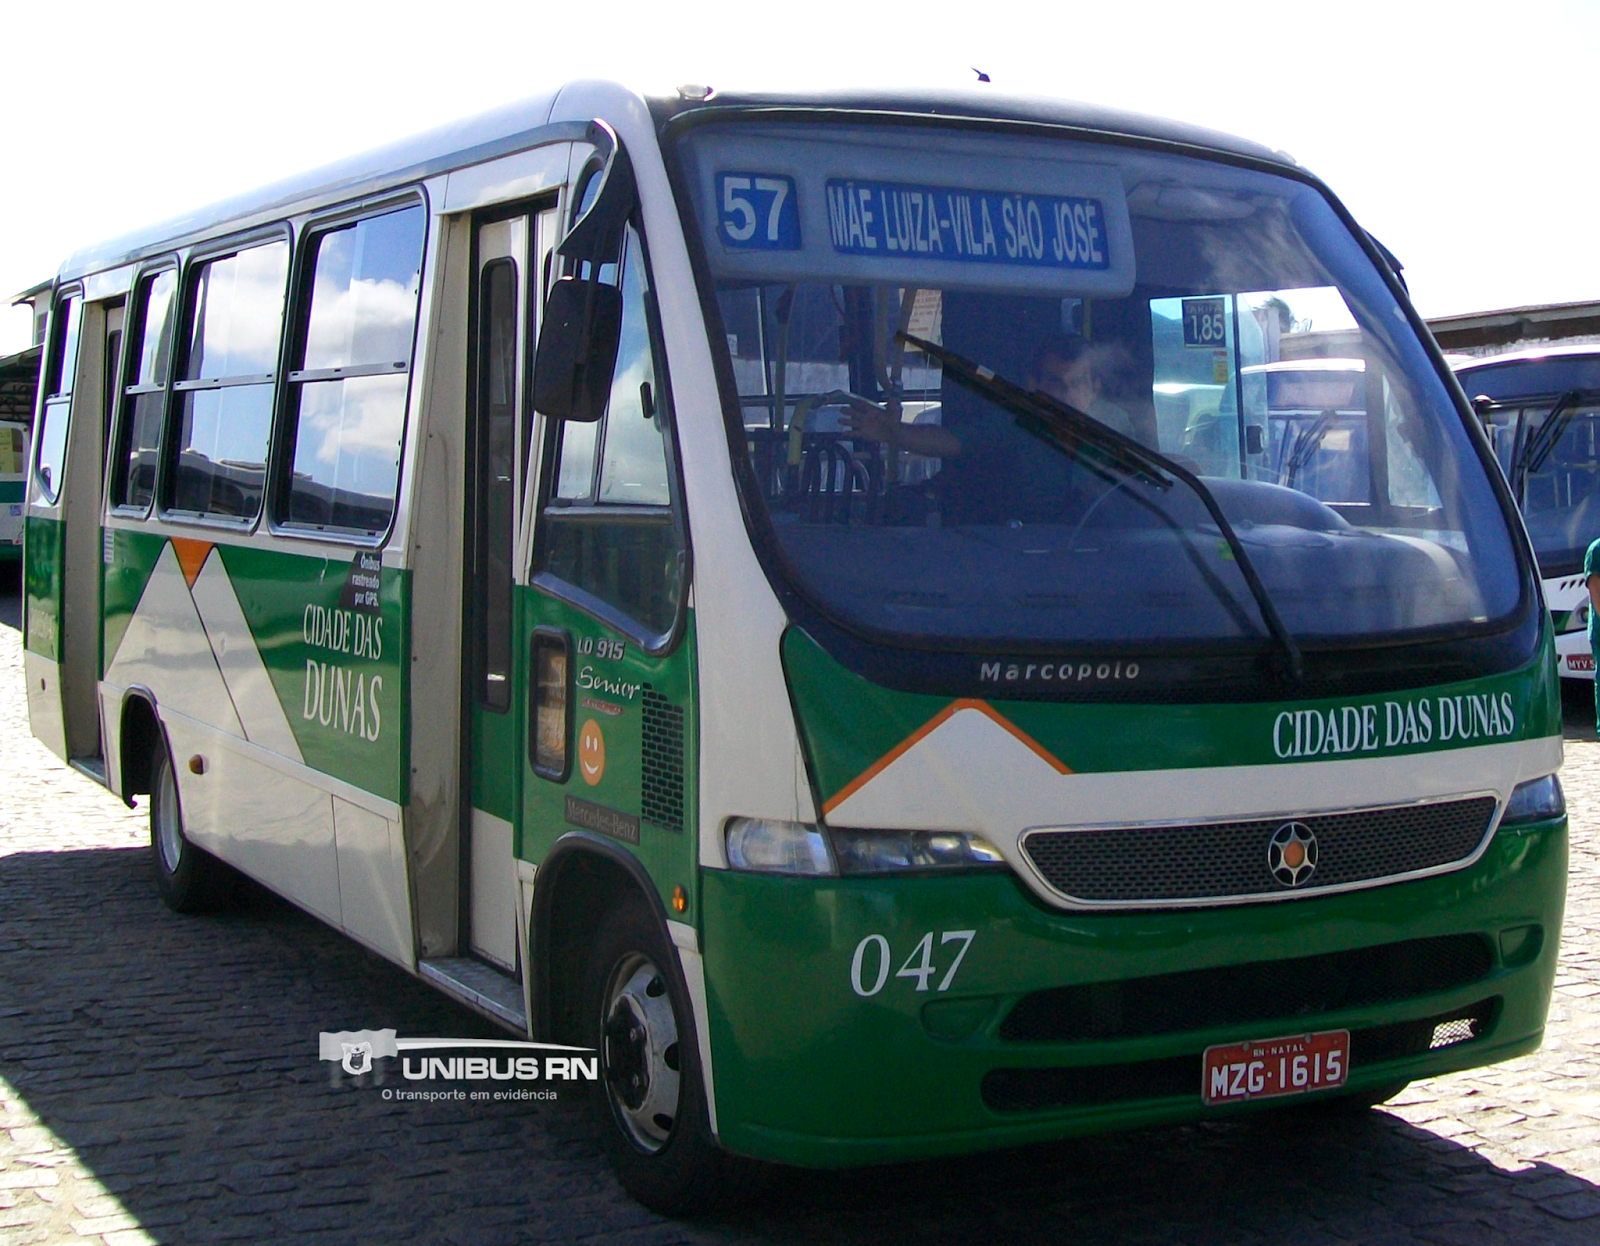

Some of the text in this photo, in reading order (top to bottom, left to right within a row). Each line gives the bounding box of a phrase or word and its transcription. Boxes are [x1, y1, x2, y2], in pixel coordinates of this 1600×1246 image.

[722, 176, 789, 242] 57
[827, 181, 877, 249] MÃE
[1002, 194, 1044, 260] SÃO
[1053, 199, 1103, 263] JOSÉ
[352, 574, 380, 589] rastreado
[303, 603, 383, 660] CIDADE DAS
[596, 637, 626, 661] 915
[303, 658, 383, 742] DUNAS
[575, 665, 641, 700] Senior
[980, 660, 1140, 682] Marcopolo
[1273, 691, 1515, 758] CIDADE DAS DUNAS
[851, 929, 977, 997] 047
